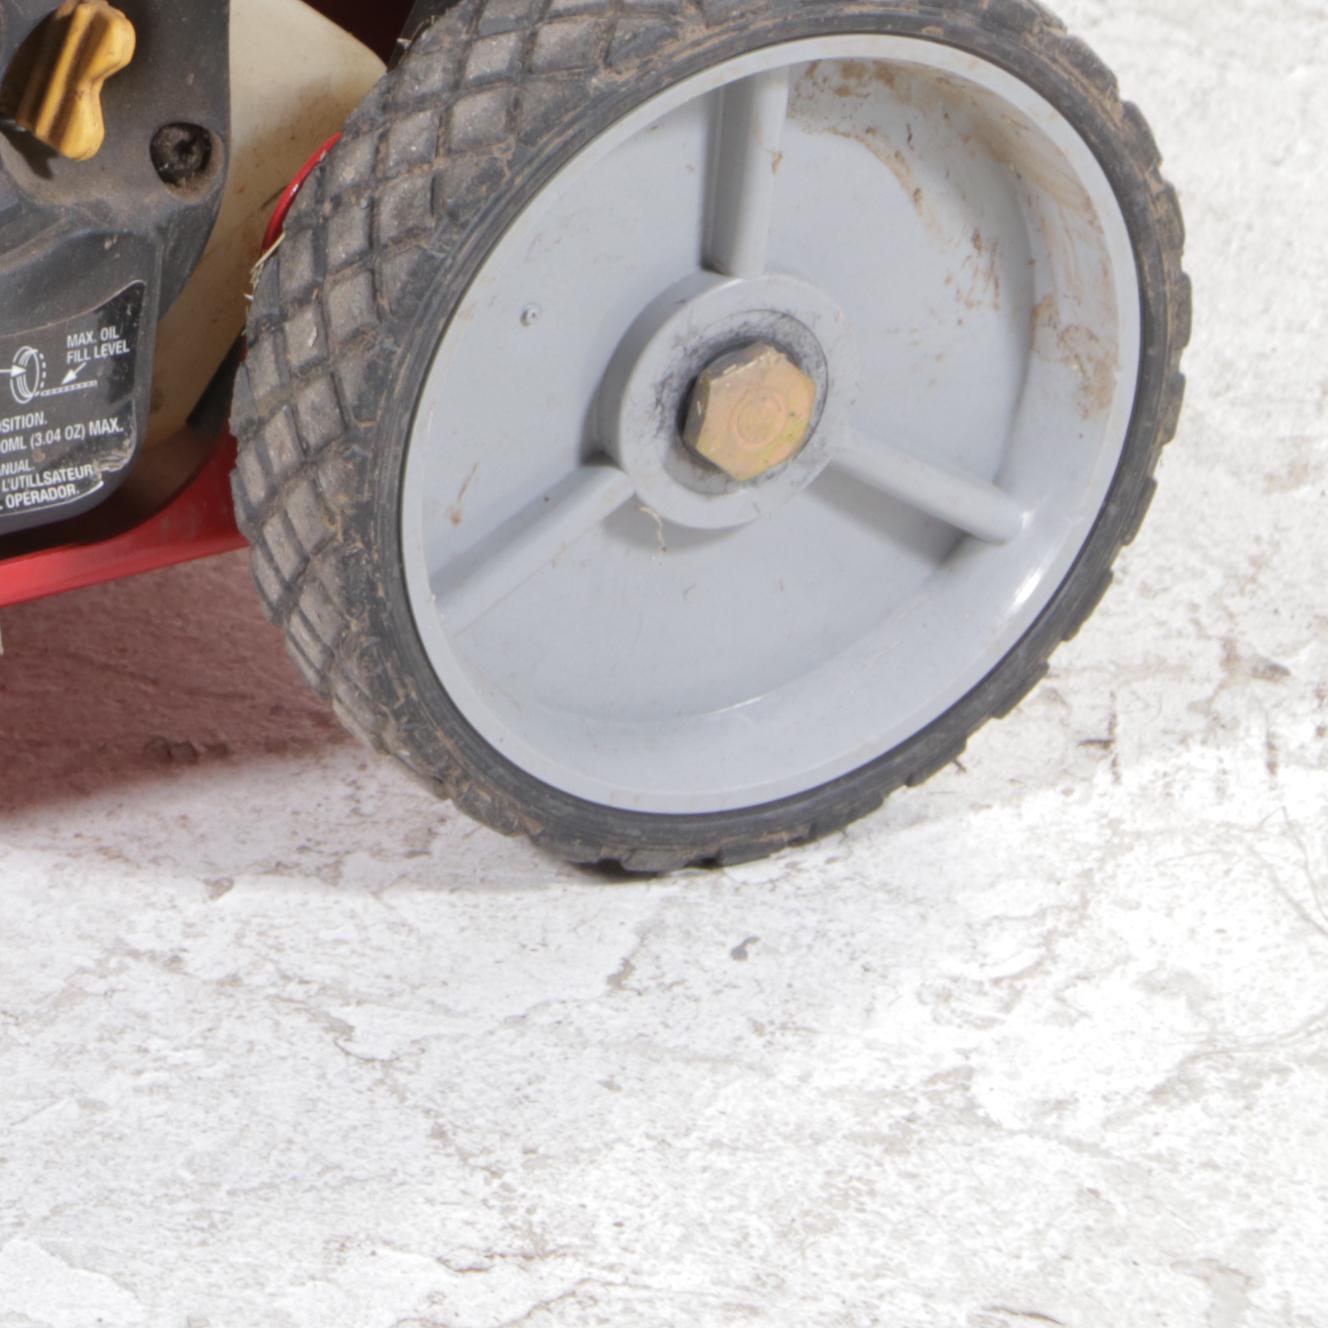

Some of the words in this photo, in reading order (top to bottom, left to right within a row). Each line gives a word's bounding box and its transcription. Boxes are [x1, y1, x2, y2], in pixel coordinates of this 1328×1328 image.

[67, 331, 96, 348] MAX.
[100, 326, 120, 341] OIL
[67, 348, 91, 364] FILL
[94, 340, 130, 359] LEVEL
[30, 428, 61, 450] (3.04
[64, 423, 87, 441] OZ)
[89, 417, 124, 436] MAX.
[5, 483, 80, 508] OPERADOR.
